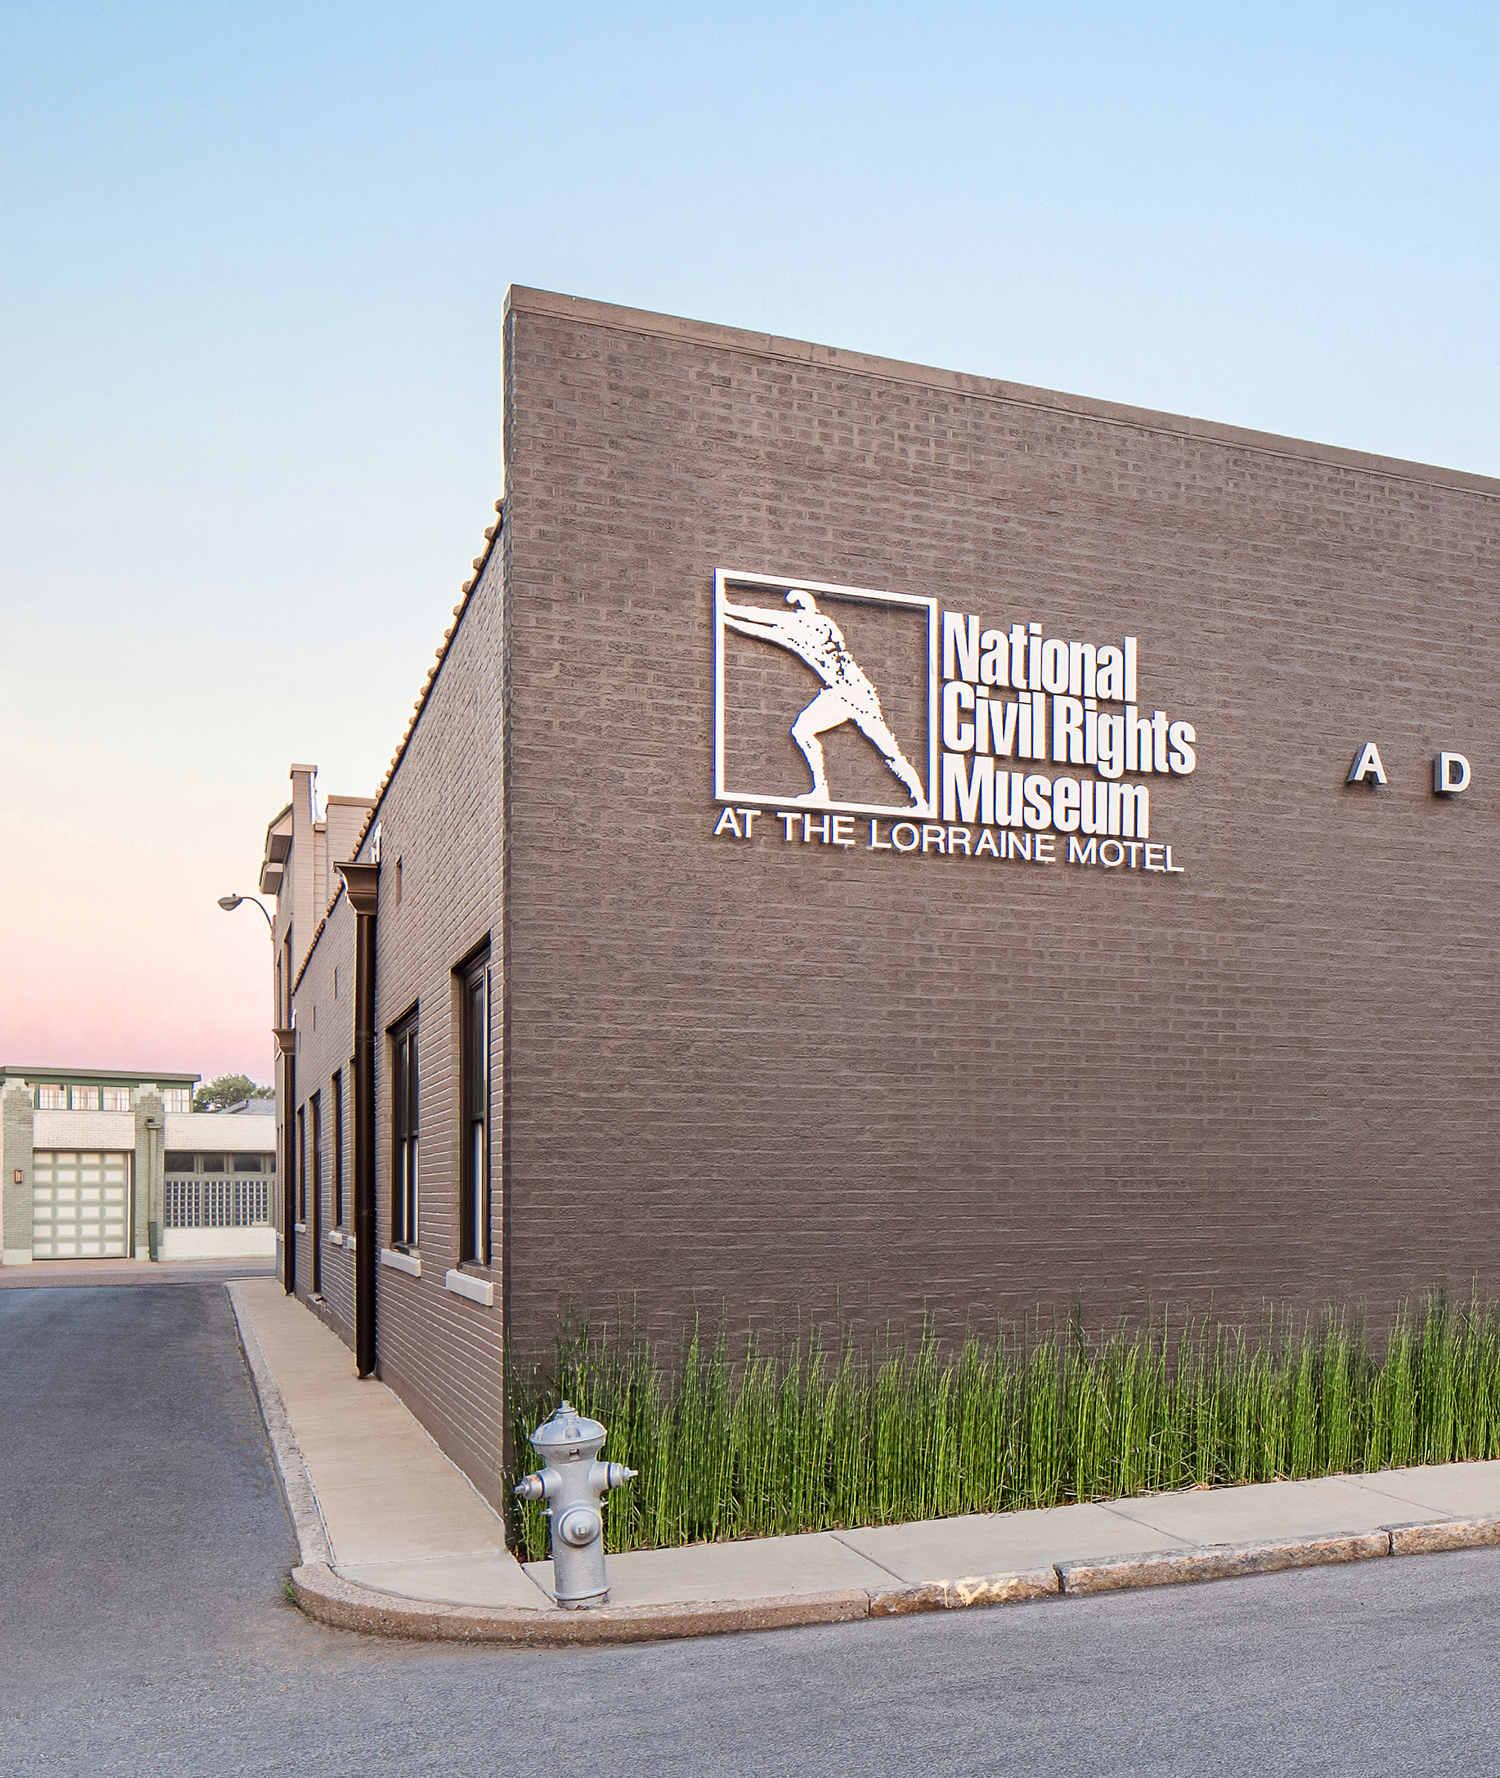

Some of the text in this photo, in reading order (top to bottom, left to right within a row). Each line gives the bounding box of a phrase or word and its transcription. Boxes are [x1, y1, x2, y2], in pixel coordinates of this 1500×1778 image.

[942, 611, 1138, 702] National
[942, 681, 1197, 778] Civil Rights
[714, 807, 1185, 873] AT THE LORRAINE MOTEL
[942, 752, 1150, 839] Museum
